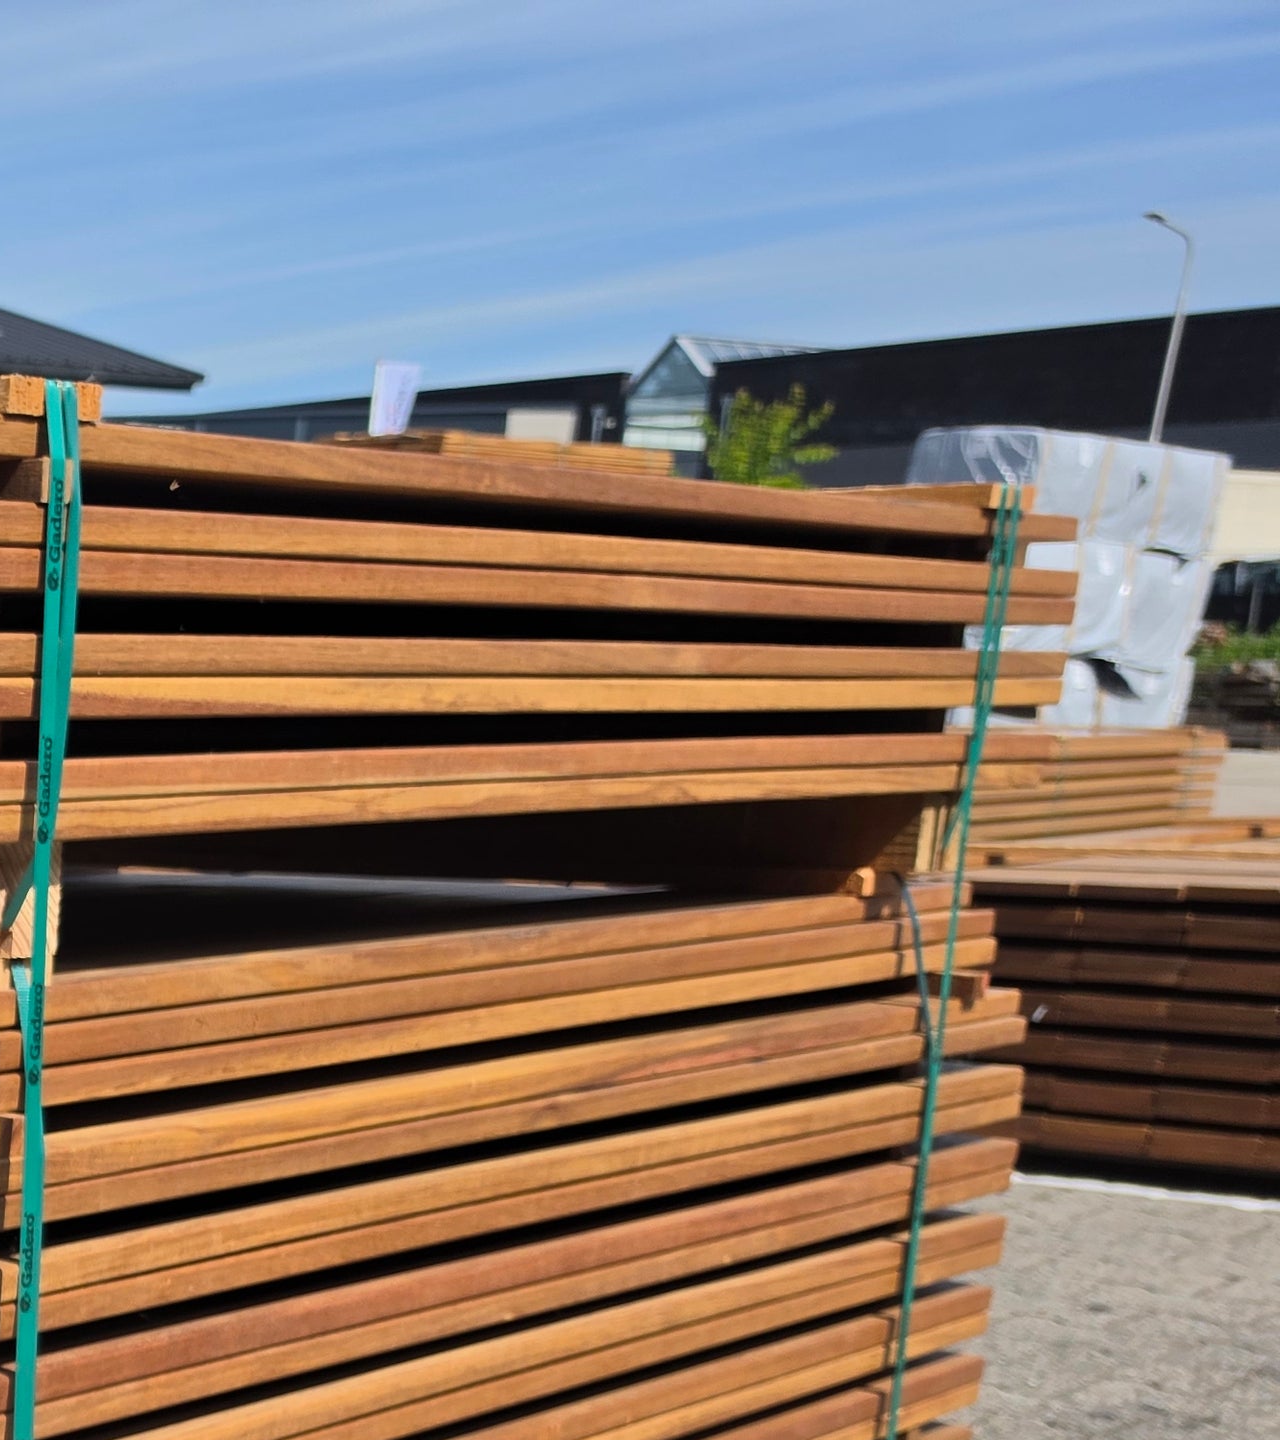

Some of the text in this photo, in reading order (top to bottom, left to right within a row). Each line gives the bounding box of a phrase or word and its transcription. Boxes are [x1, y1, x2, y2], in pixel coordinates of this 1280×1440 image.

[49, 478, 63, 563] Gadero
[39, 737, 52, 817] Gadero
[30, 983, 43, 1060] Gadero
[21, 1213, 34, 1288] Gadero
